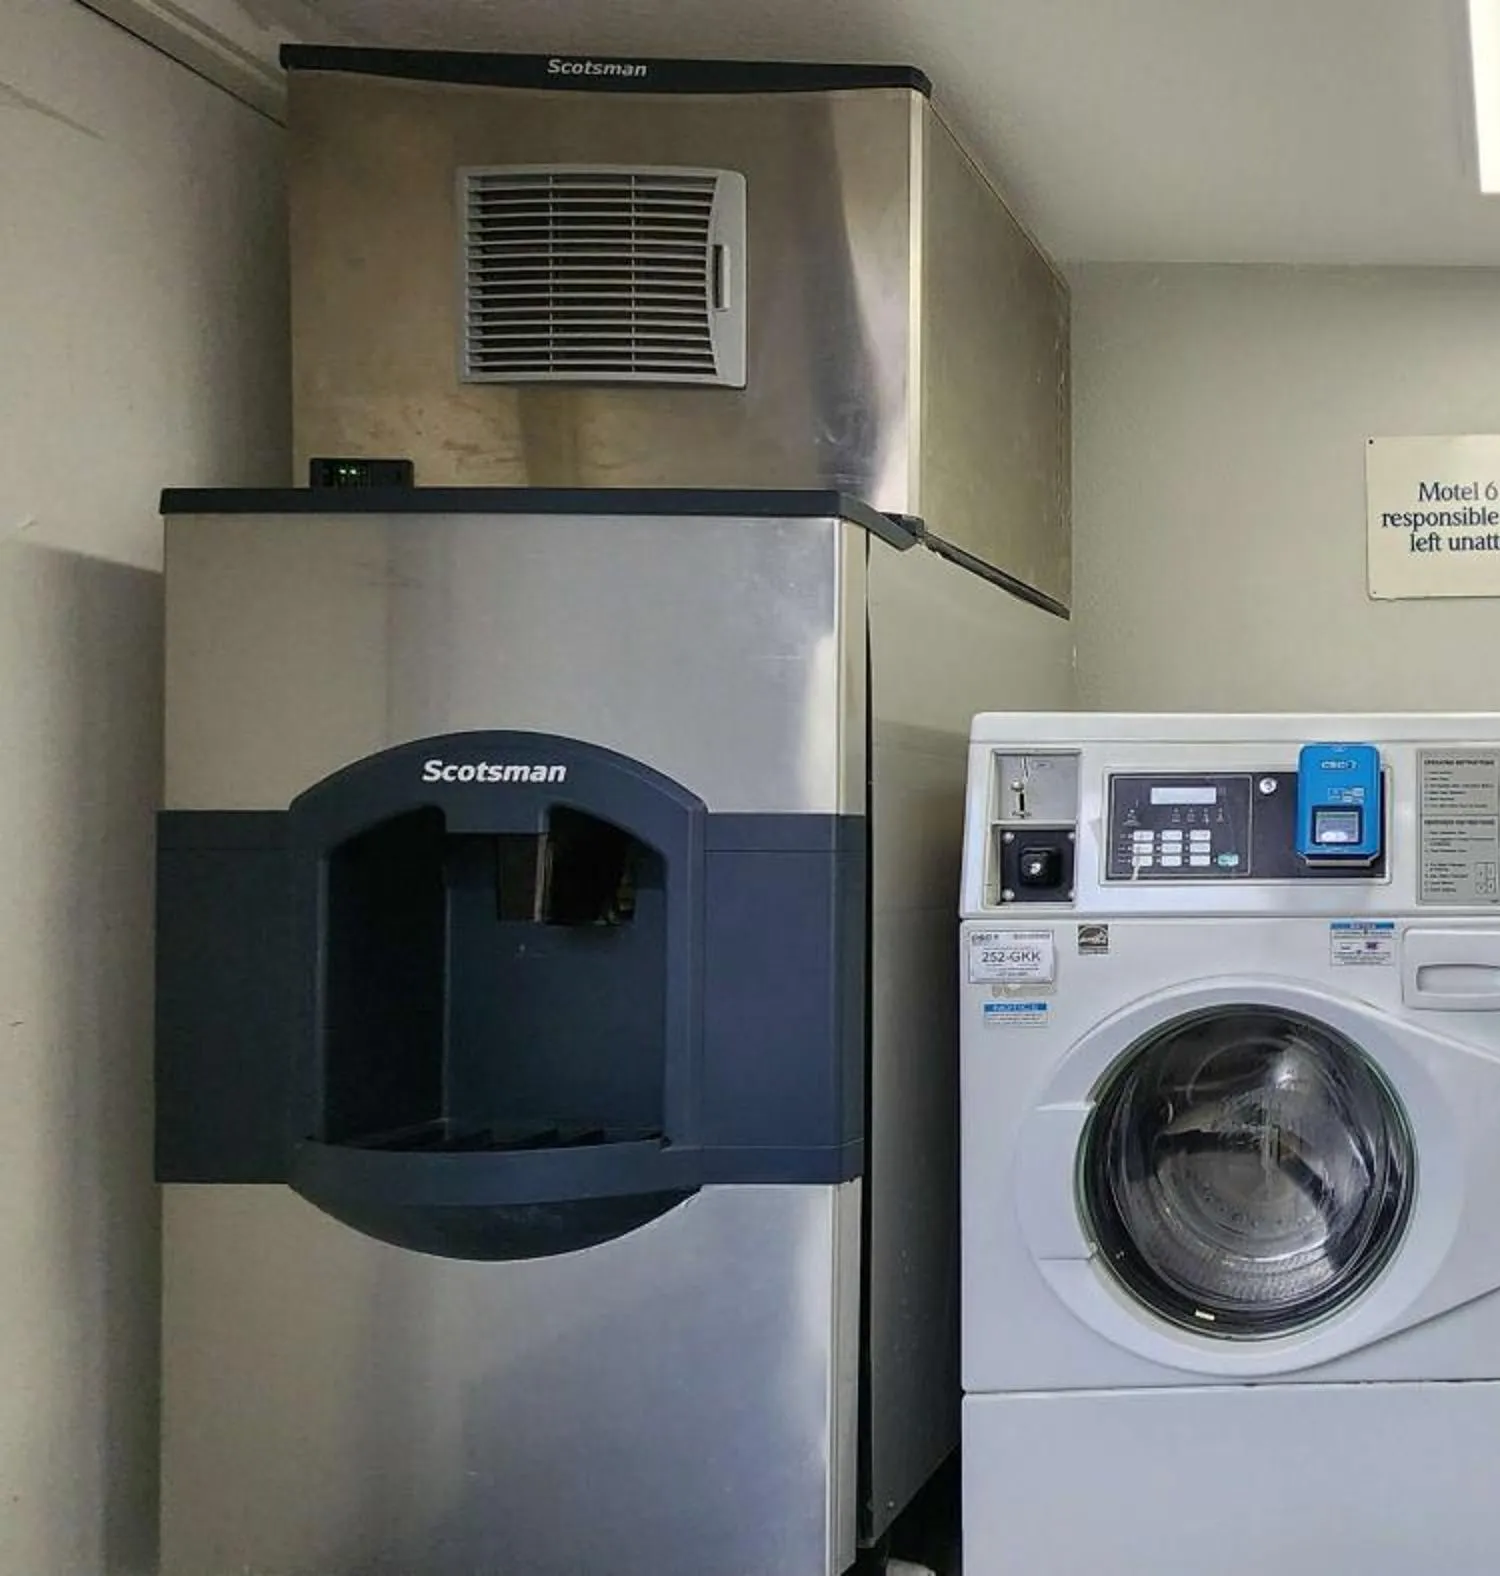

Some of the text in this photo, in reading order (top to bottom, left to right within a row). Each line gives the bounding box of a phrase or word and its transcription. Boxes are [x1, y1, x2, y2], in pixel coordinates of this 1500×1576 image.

[547, 58, 648, 77] Scotsman
[1418, 481, 1479, 502] Motel
[1485, 481, 1498, 501] 6
[1382, 506, 1499, 531] responsible
[1410, 532, 1442, 553] left
[422, 759, 567, 783] Scotsman
[981, 951, 1041, 963] 252-GKK
